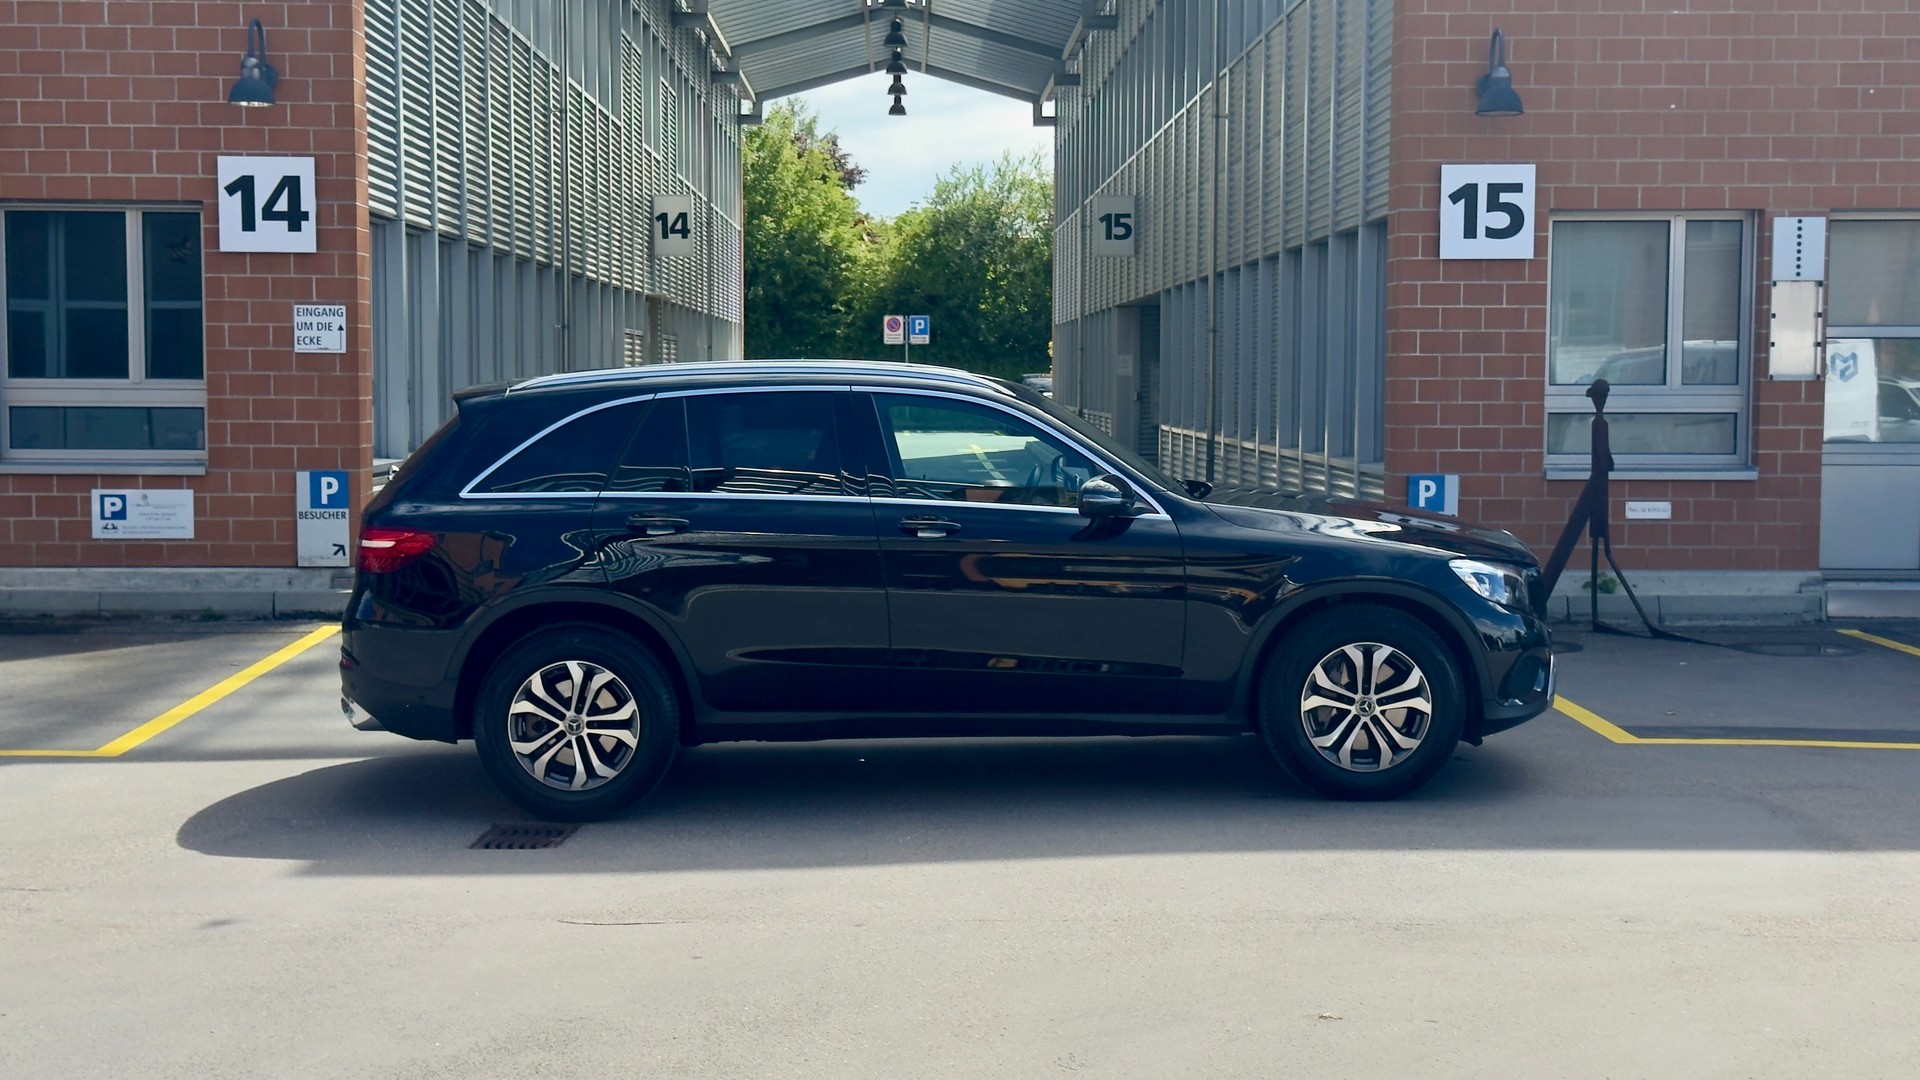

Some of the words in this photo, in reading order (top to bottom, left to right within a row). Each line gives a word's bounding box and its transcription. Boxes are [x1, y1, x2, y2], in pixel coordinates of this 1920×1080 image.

[223, 175, 310, 232] 14
[1448, 182, 1525, 240] 15
[655, 212, 690, 239] 14
[1099, 213, 1132, 240] 15
[296, 307, 344, 317] EINGANG
[296, 321, 313, 331] UM
[316, 321, 333, 331] DIE
[915, 319, 925, 334] P
[296, 335, 322, 346] ECKE
[321, 476, 339, 505] P
[1418, 479, 1437, 507] P
[103, 496, 123, 518] P
[298, 510, 347, 520] BESUCHER
